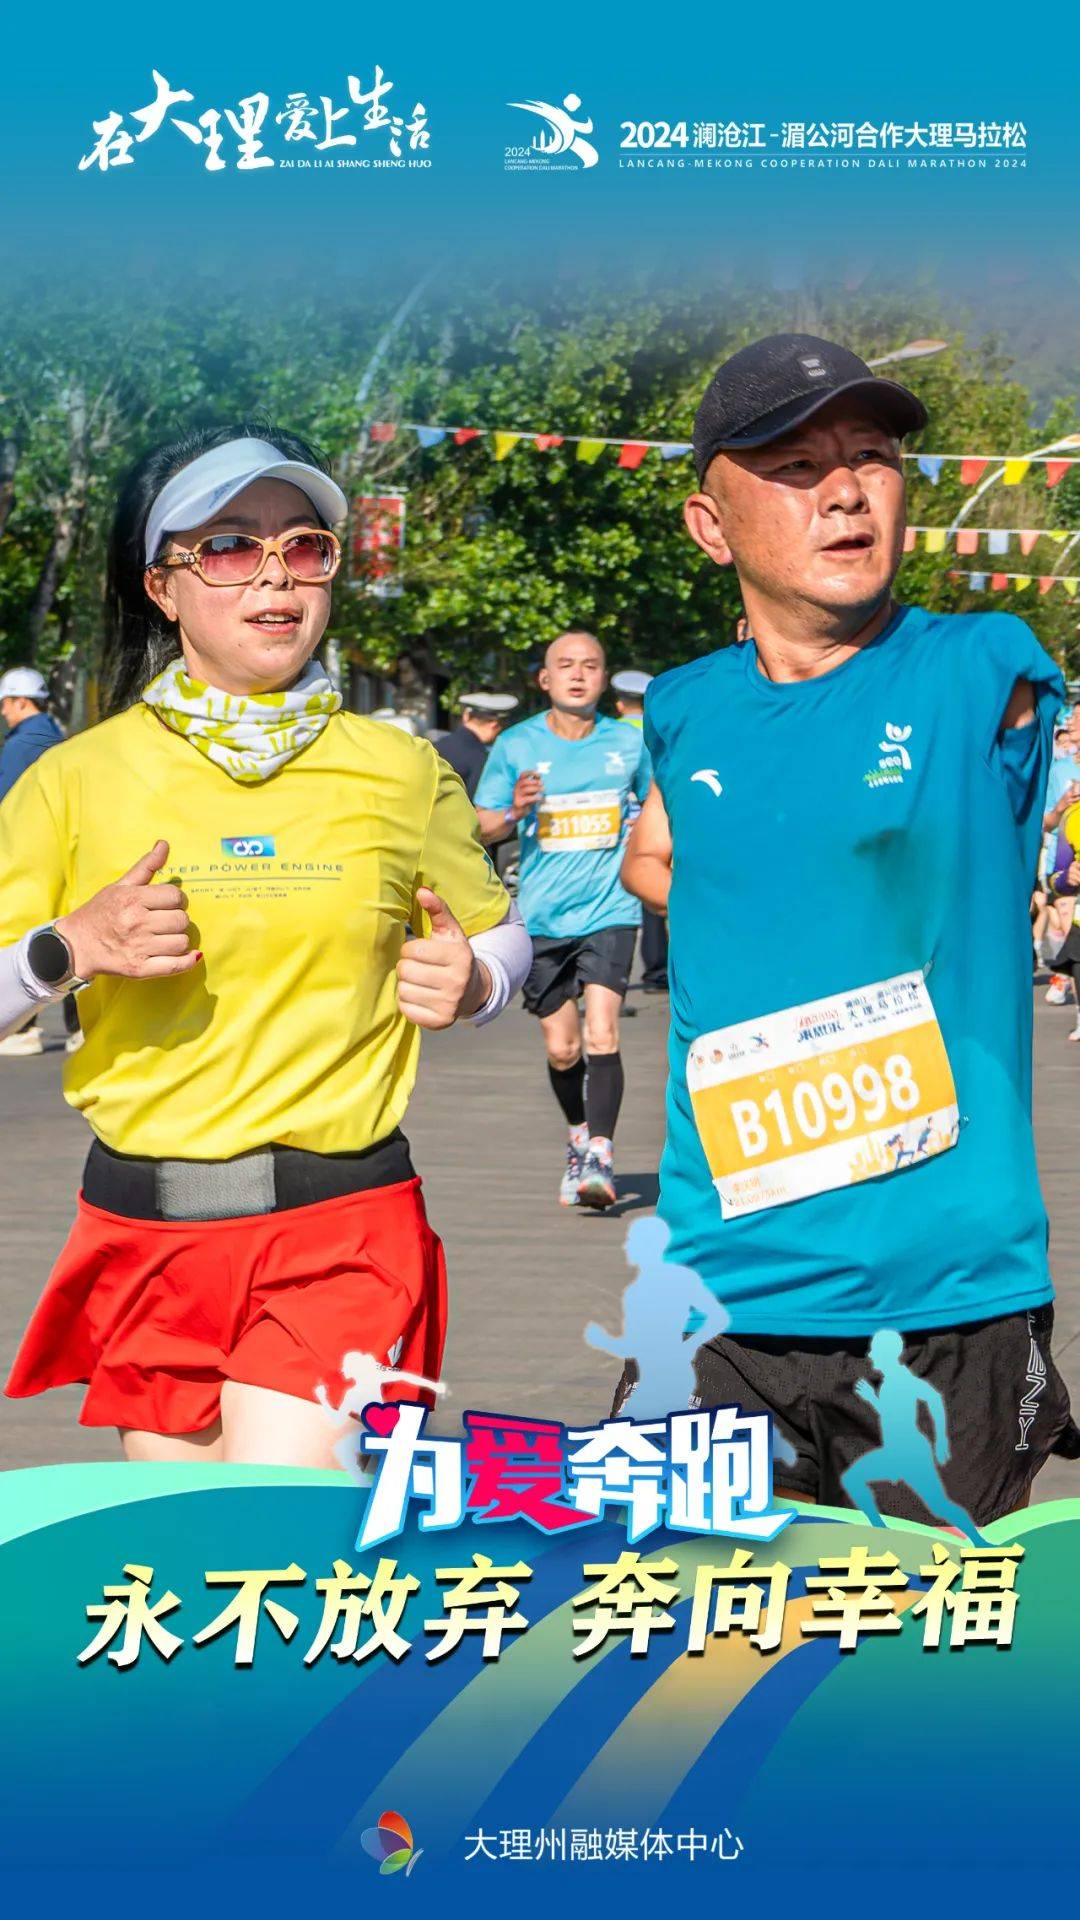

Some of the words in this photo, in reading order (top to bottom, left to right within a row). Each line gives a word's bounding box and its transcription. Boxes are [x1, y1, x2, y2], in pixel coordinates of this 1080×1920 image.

[209, 862, 271, 873] POWER
[281, 862, 344, 873] ENGINE
[729, 1053, 920, 1159] B10998
